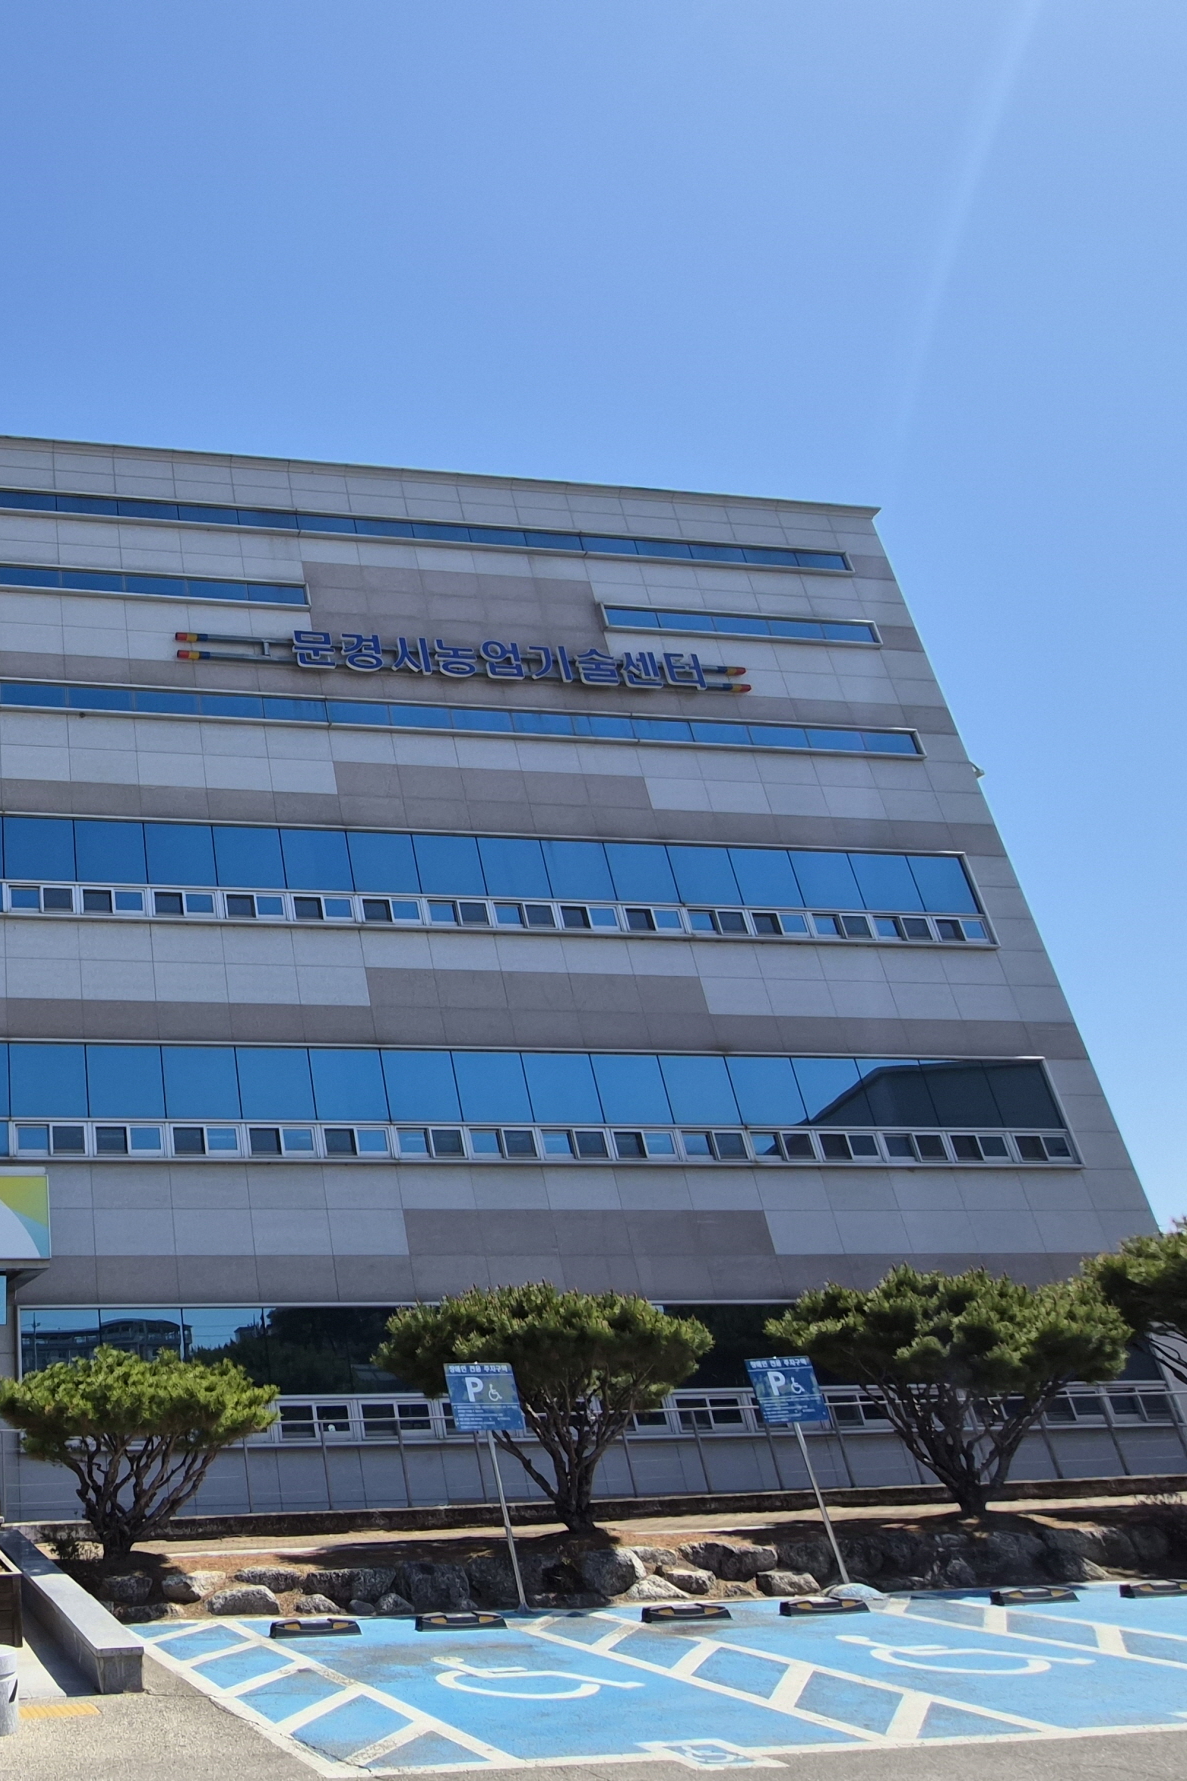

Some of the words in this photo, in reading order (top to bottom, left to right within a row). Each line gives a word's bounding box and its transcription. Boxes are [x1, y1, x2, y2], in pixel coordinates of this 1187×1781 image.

[292, 629, 708, 690] 문경시농업기술센터
[465, 1377, 484, 1402] P
[767, 1372, 785, 1395] P
